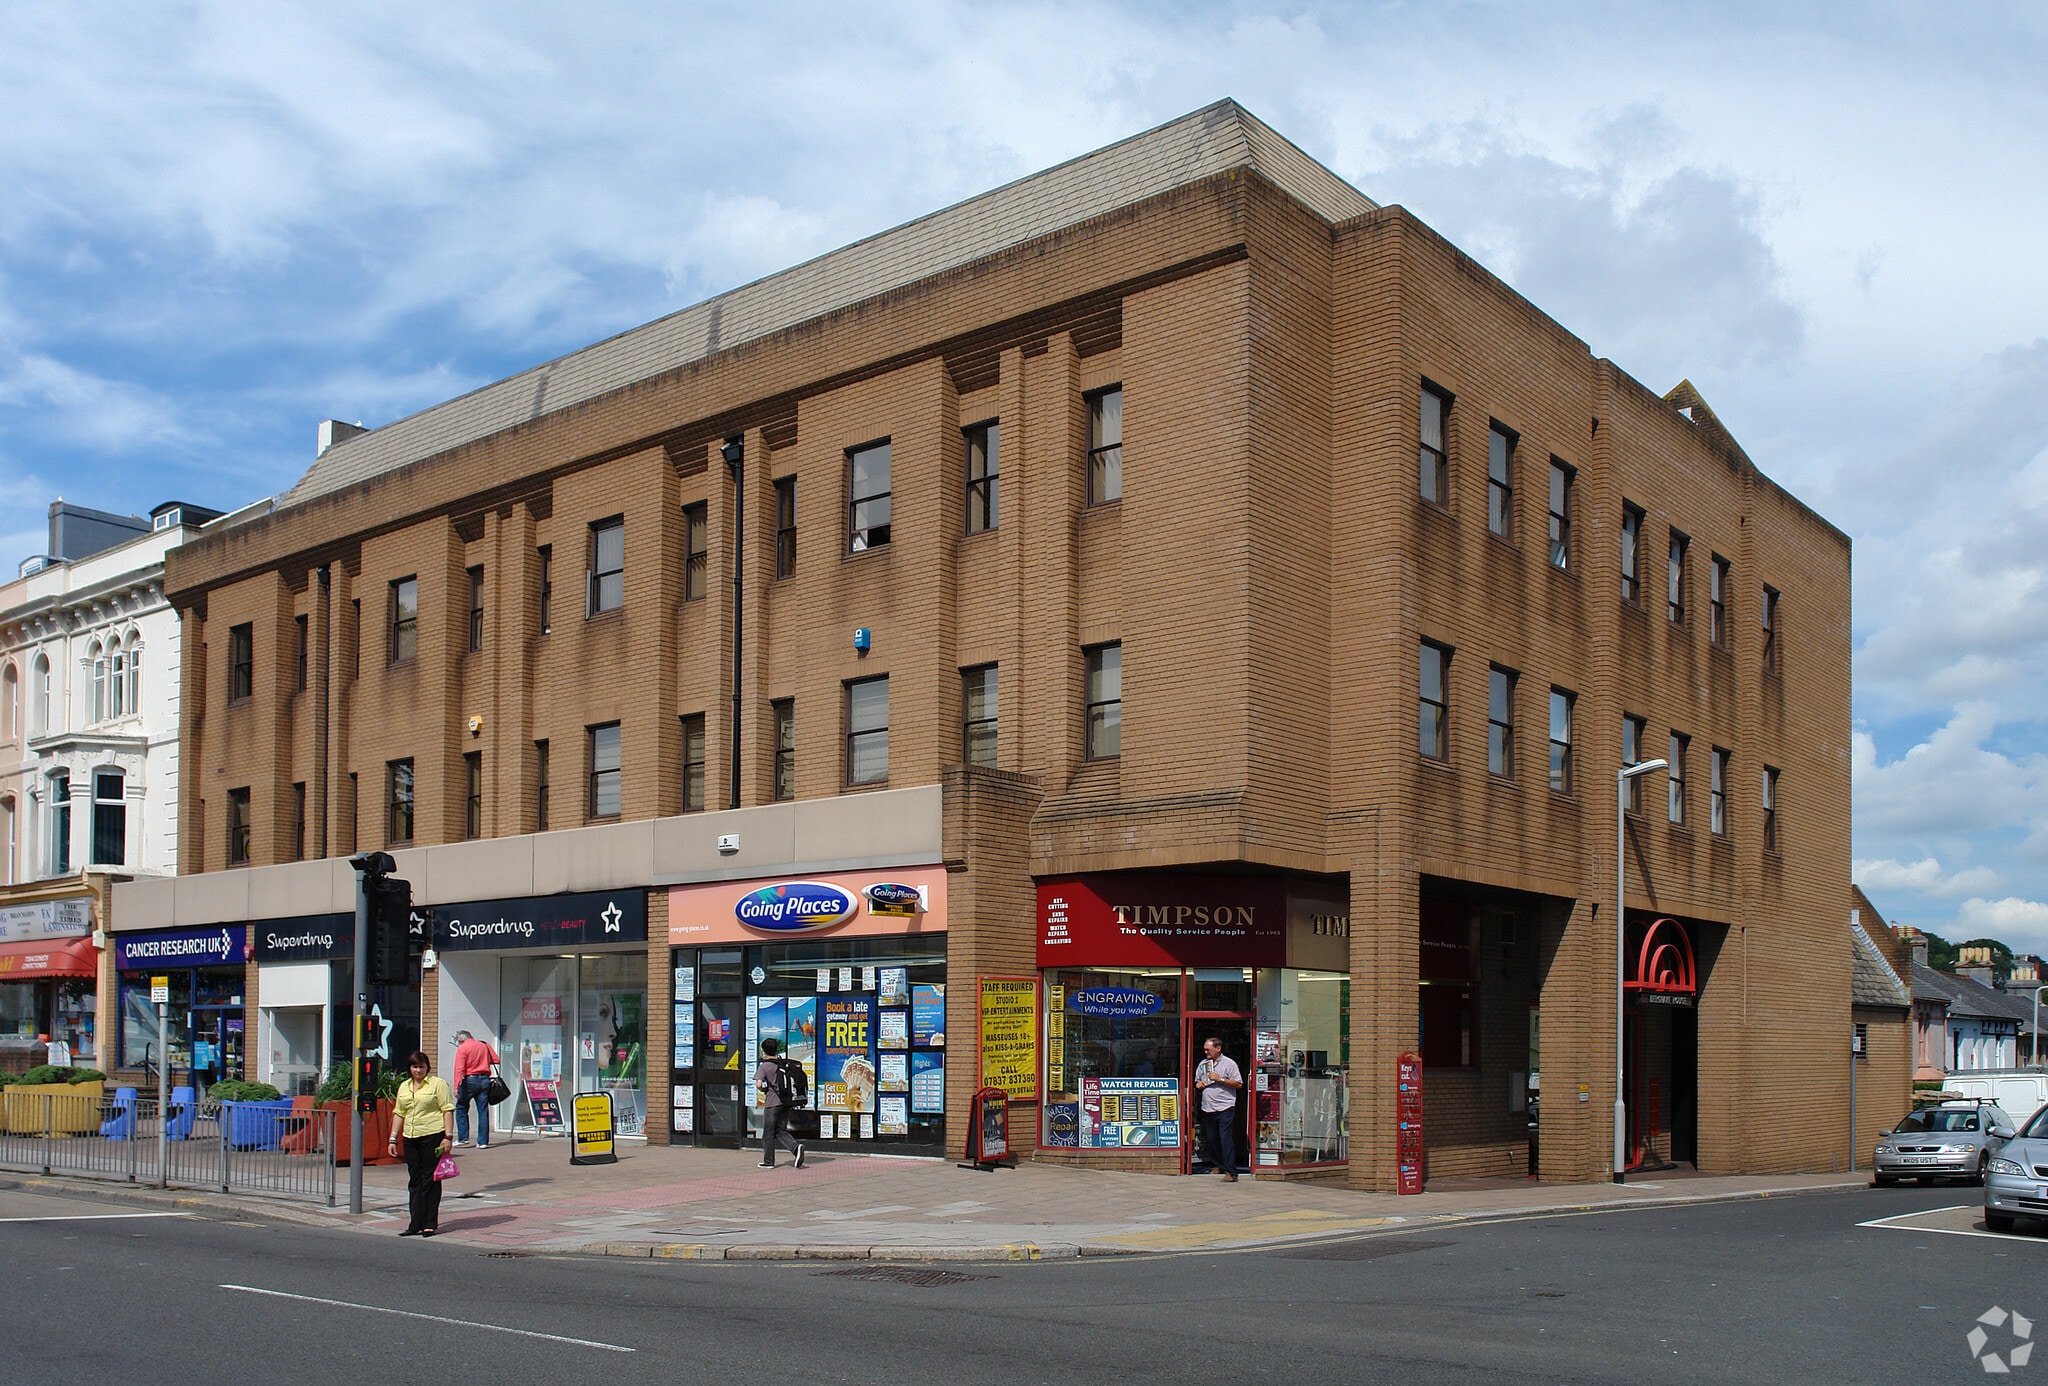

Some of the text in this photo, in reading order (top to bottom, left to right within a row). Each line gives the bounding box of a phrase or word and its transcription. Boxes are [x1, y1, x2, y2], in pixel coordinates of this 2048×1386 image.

[874, 888, 918, 899] Going Places
[740, 897, 841, 921] Going Places
[1112, 905, 1256, 926] TIMPSON
[449, 918, 534, 939] Superdrug
[560, 920, 587, 929] BEAUTY
[1140, 928, 1172, 936] Quality
[266, 932, 334, 951] Superdrug
[126, 937, 221, 958] CANCER RESEARCH UK
[981, 982, 1034, 992] STAFF REQUIRED
[996, 996, 1019, 1005] STUDIO 2
[1077, 991, 1155, 1005] ENGRAVING
[826, 1001, 868, 1012] Book a late
[990, 1006, 1034, 1015] ENTERTAINMENTS
[1084, 1005, 1148, 1016] While you wait
[524, 1010, 540, 1019] ONLY
[826, 1013, 848, 1021] getaway
[859, 1013, 868, 1021] get
[826, 1022, 869, 1047] FREE
[985, 1032, 1030, 1041] MASSEUSES 18+
[982, 1041, 1035, 1053] also KISS-A-GRAMS
[1000, 1065, 1018, 1075] CALL
[1401, 1064, 1413, 1074] Keys
[983, 1073, 1036, 1087] 07837 837380
[1134, 1080, 1169, 1088] REPAIRS
[1085, 1083, 1098, 1091] Life
[825, 1093, 846, 1105] FREE
[1048, 1104, 1077, 1119] WATCH
[1049, 1121, 1078, 1131] Repair
[1103, 1125, 1117, 1135] FREE
[1160, 1125, 1177, 1135] WATCH
